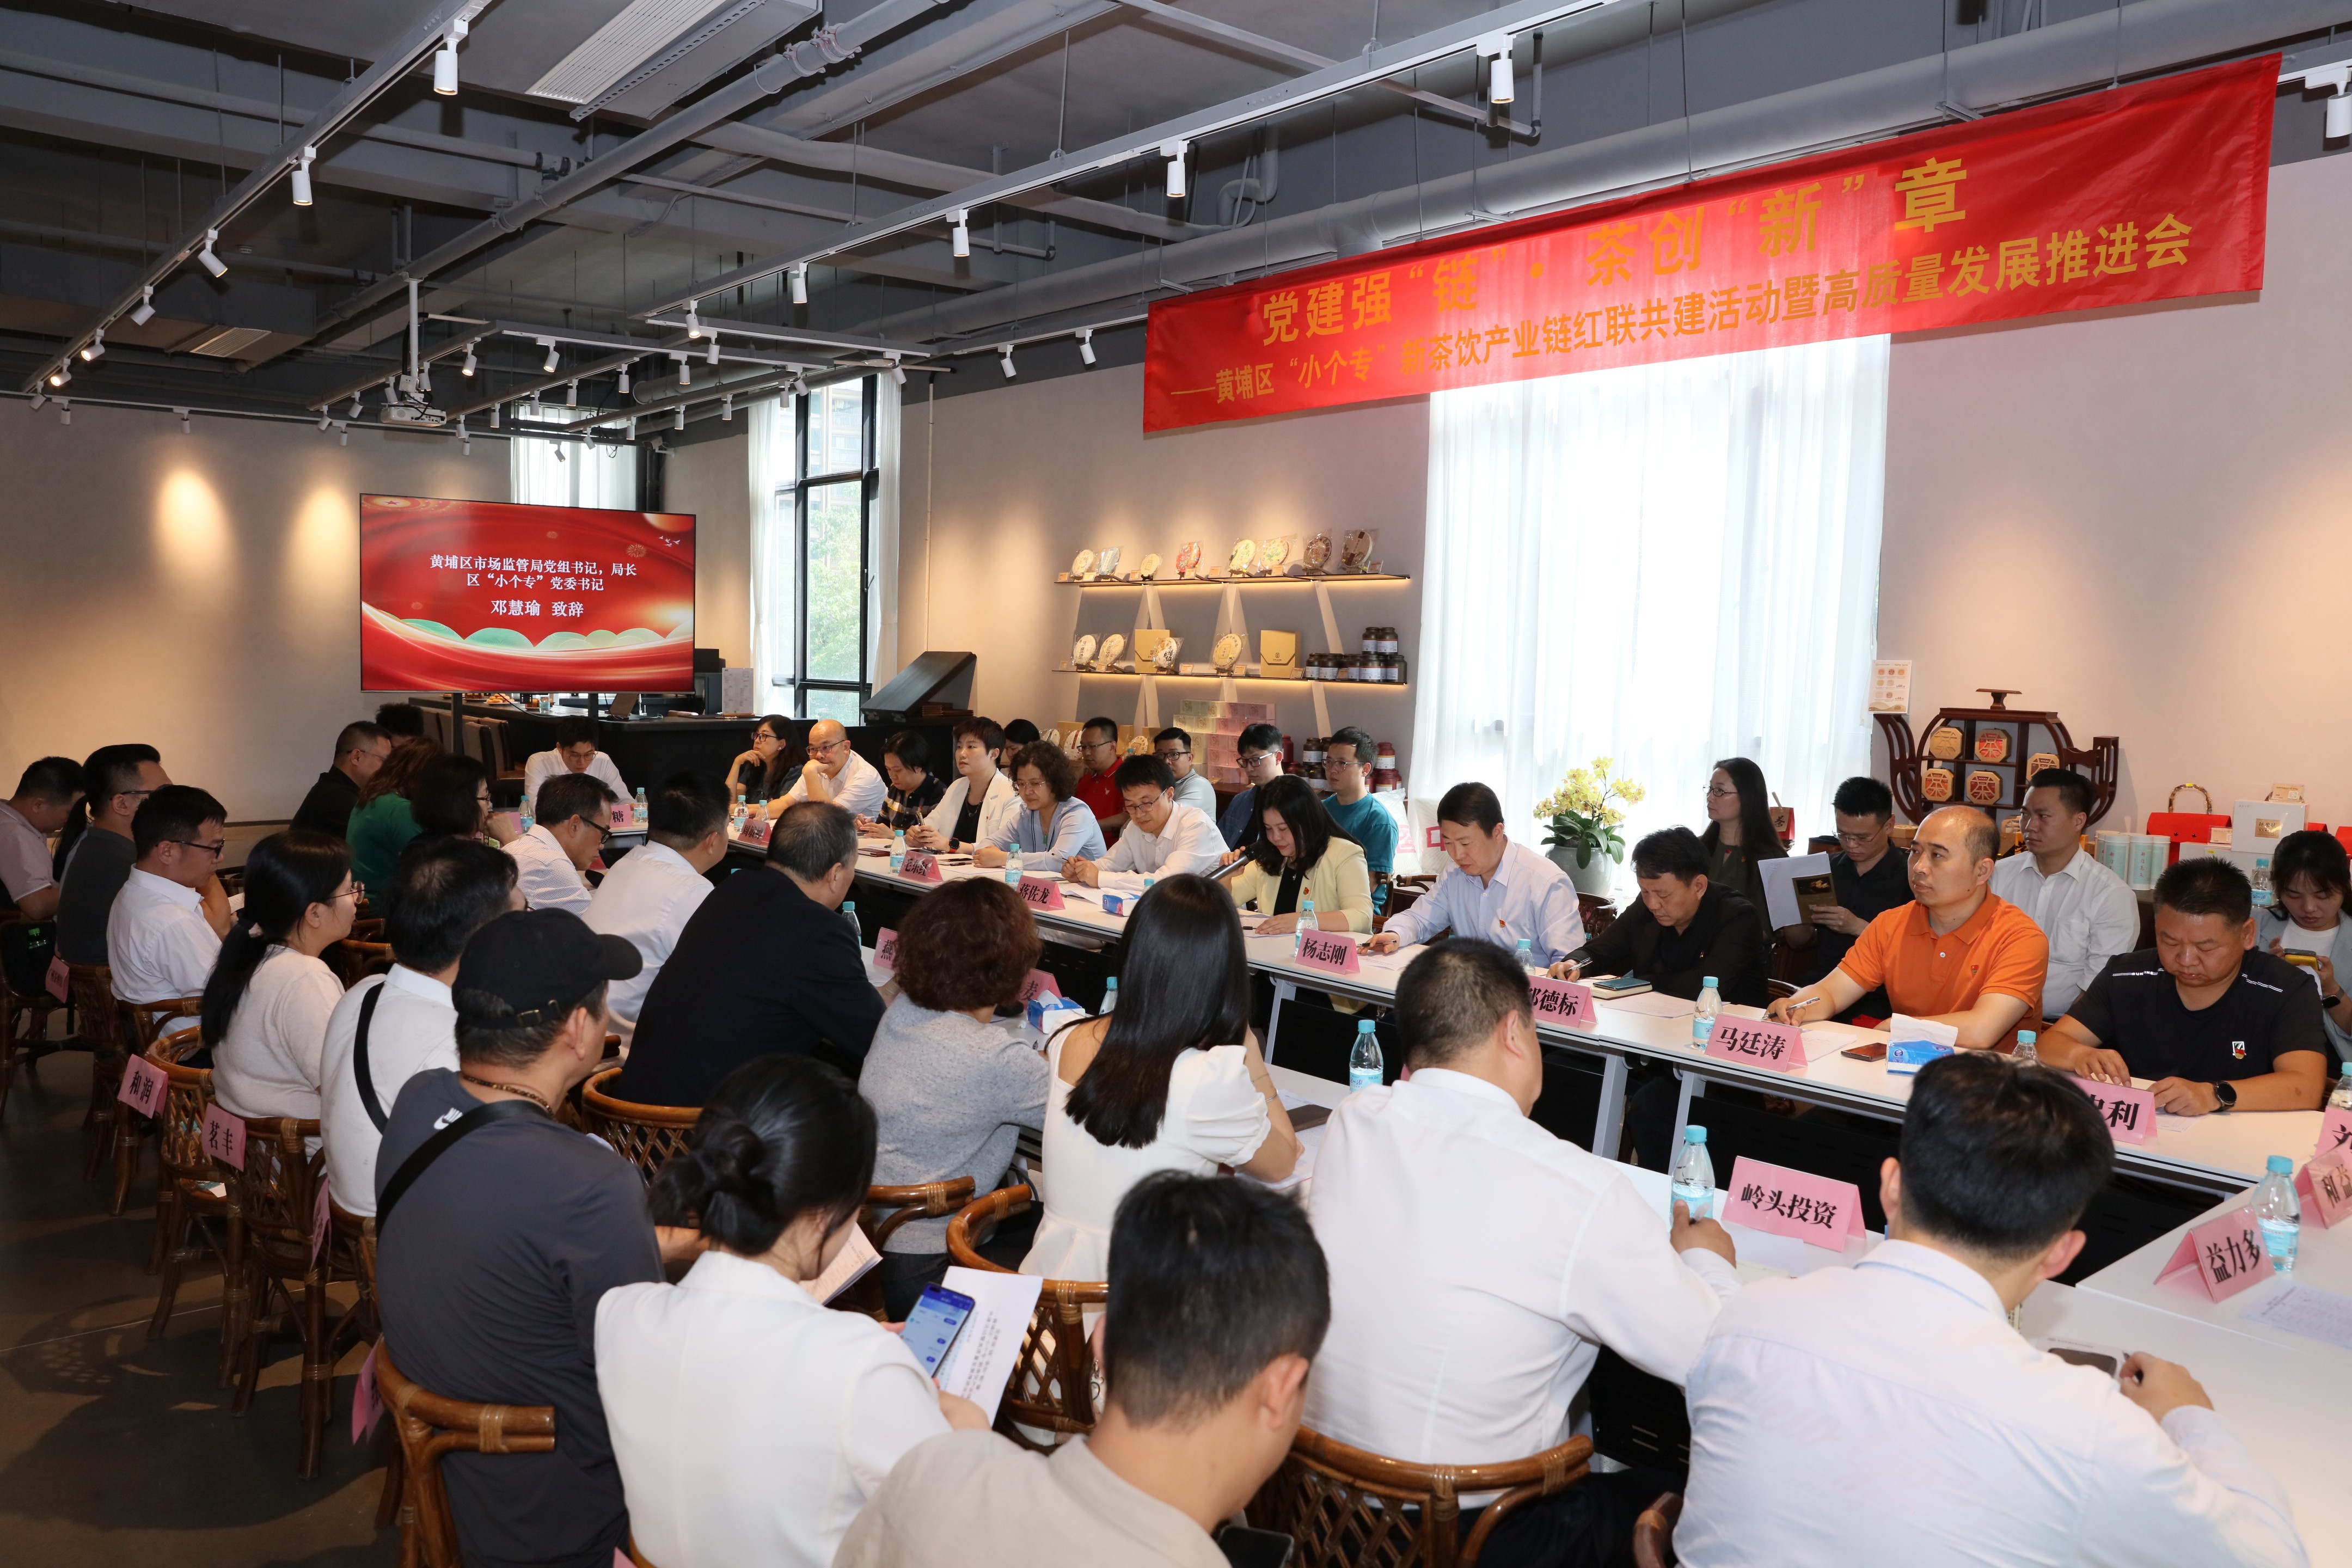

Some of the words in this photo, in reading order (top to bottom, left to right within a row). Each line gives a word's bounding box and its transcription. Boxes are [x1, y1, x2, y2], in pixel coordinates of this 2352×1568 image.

[491, 599, 541, 617] 邓慧瑜
[552, 601, 584, 618] 致辞
[611, 811, 624, 823] 糖
[1019, 883, 1050, 904] 蒋佐龙
[1302, 938, 1348, 966] 杨志刚
[1716, 1026, 1787, 1060] 马廷涛
[129, 1070, 154, 1104] 和润
[209, 1120, 234, 1156] 茗丰
[1740, 1183, 1838, 1229] 岭头投资
[2206, 1229, 2261, 1284] 益力多
